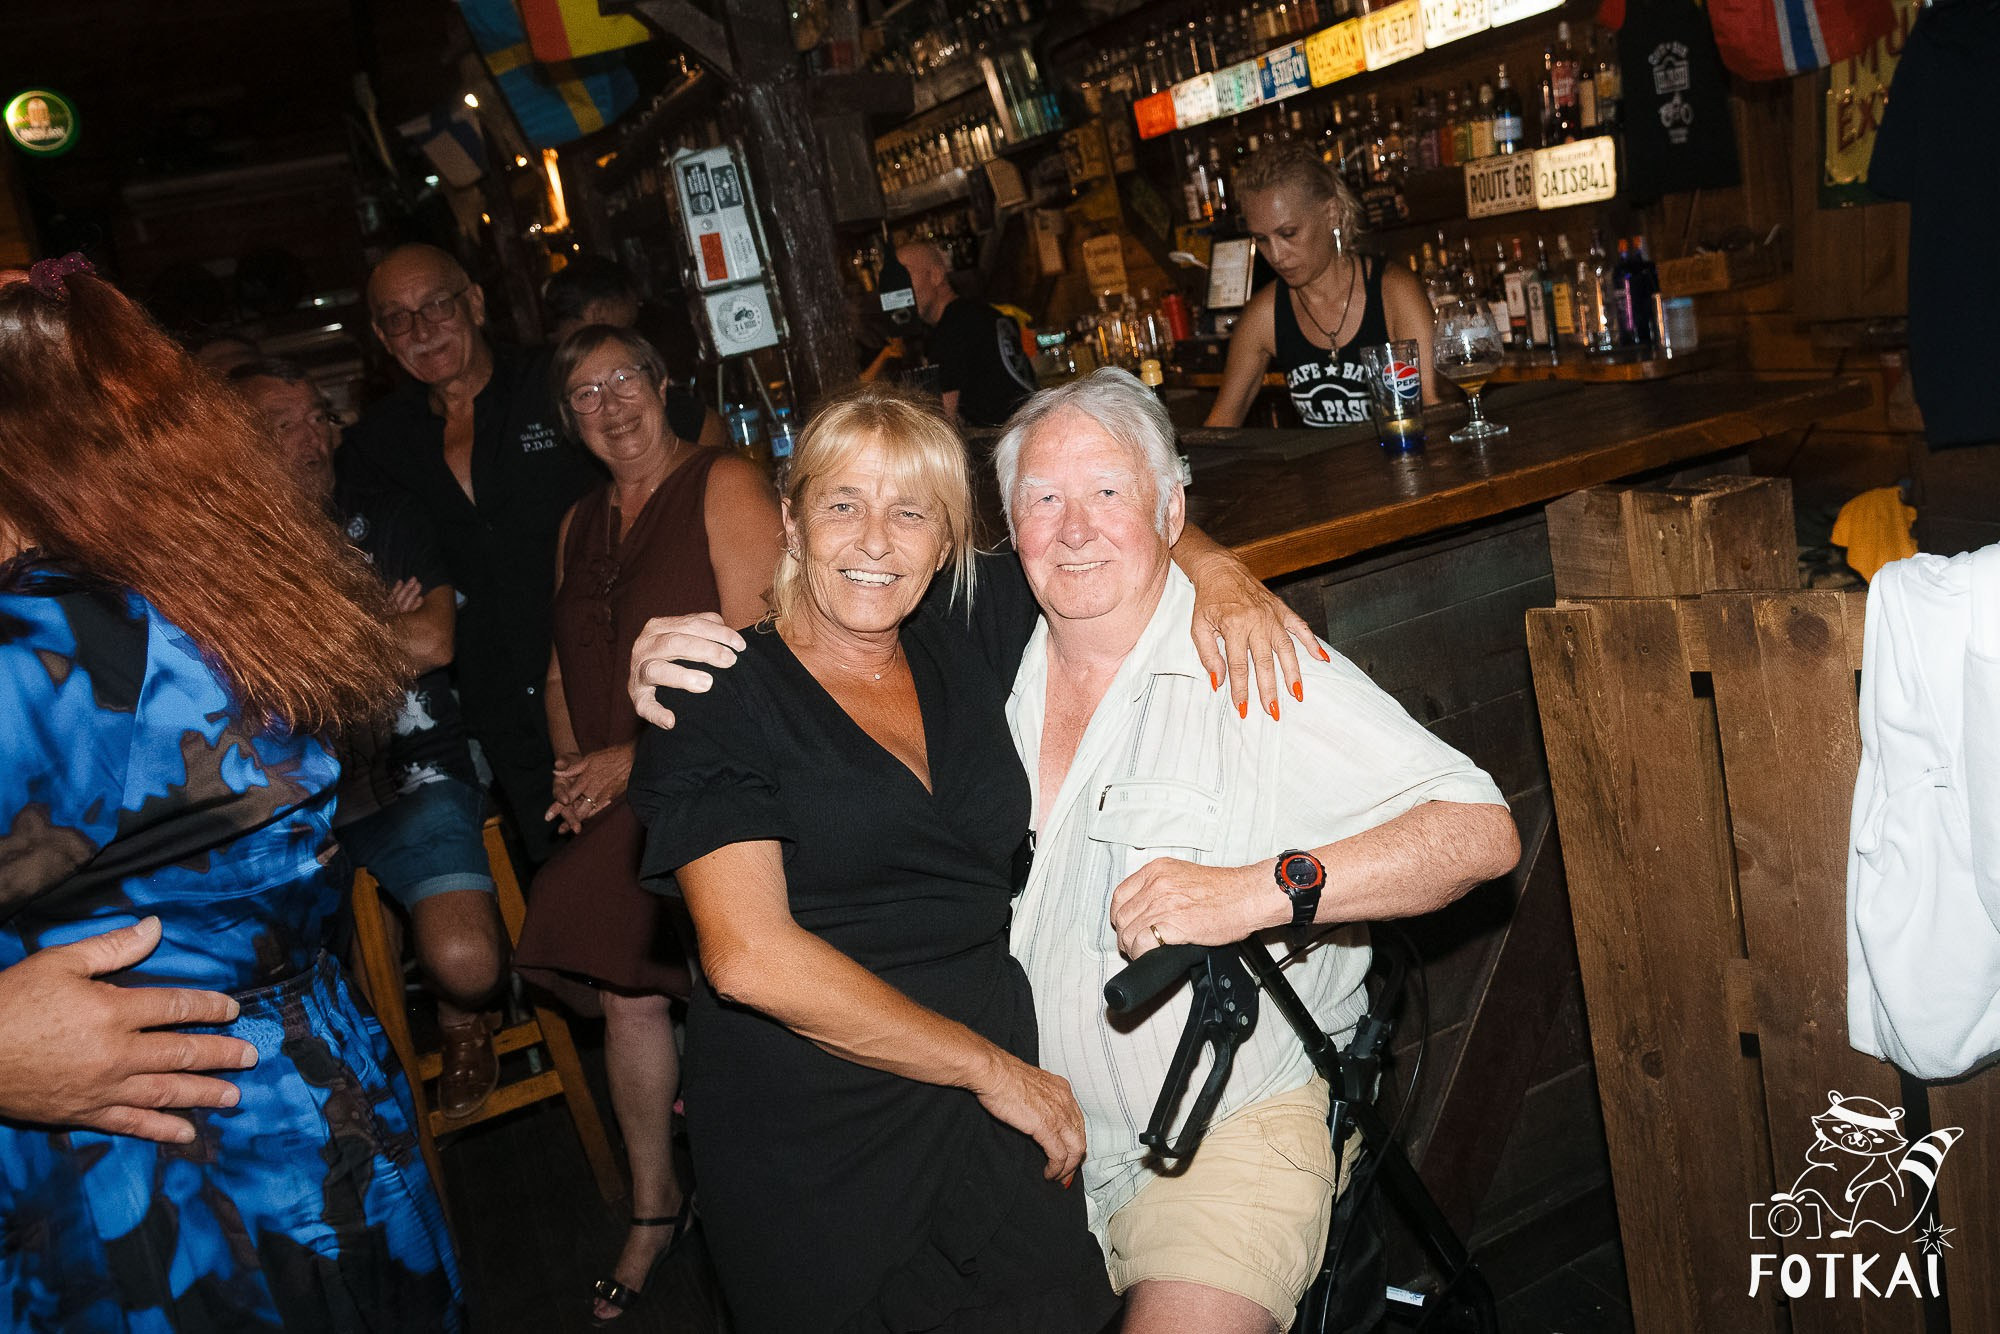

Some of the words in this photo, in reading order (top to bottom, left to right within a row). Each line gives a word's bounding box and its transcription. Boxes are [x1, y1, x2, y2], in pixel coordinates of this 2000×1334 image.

[1470, 167, 1511, 204] ROUTE
[1513, 163, 1532, 196] 66
[1540, 161, 1609, 198] 3AIS841
[1287, 362, 1321, 389] CAFE
[1295, 400, 1324, 421] EL
